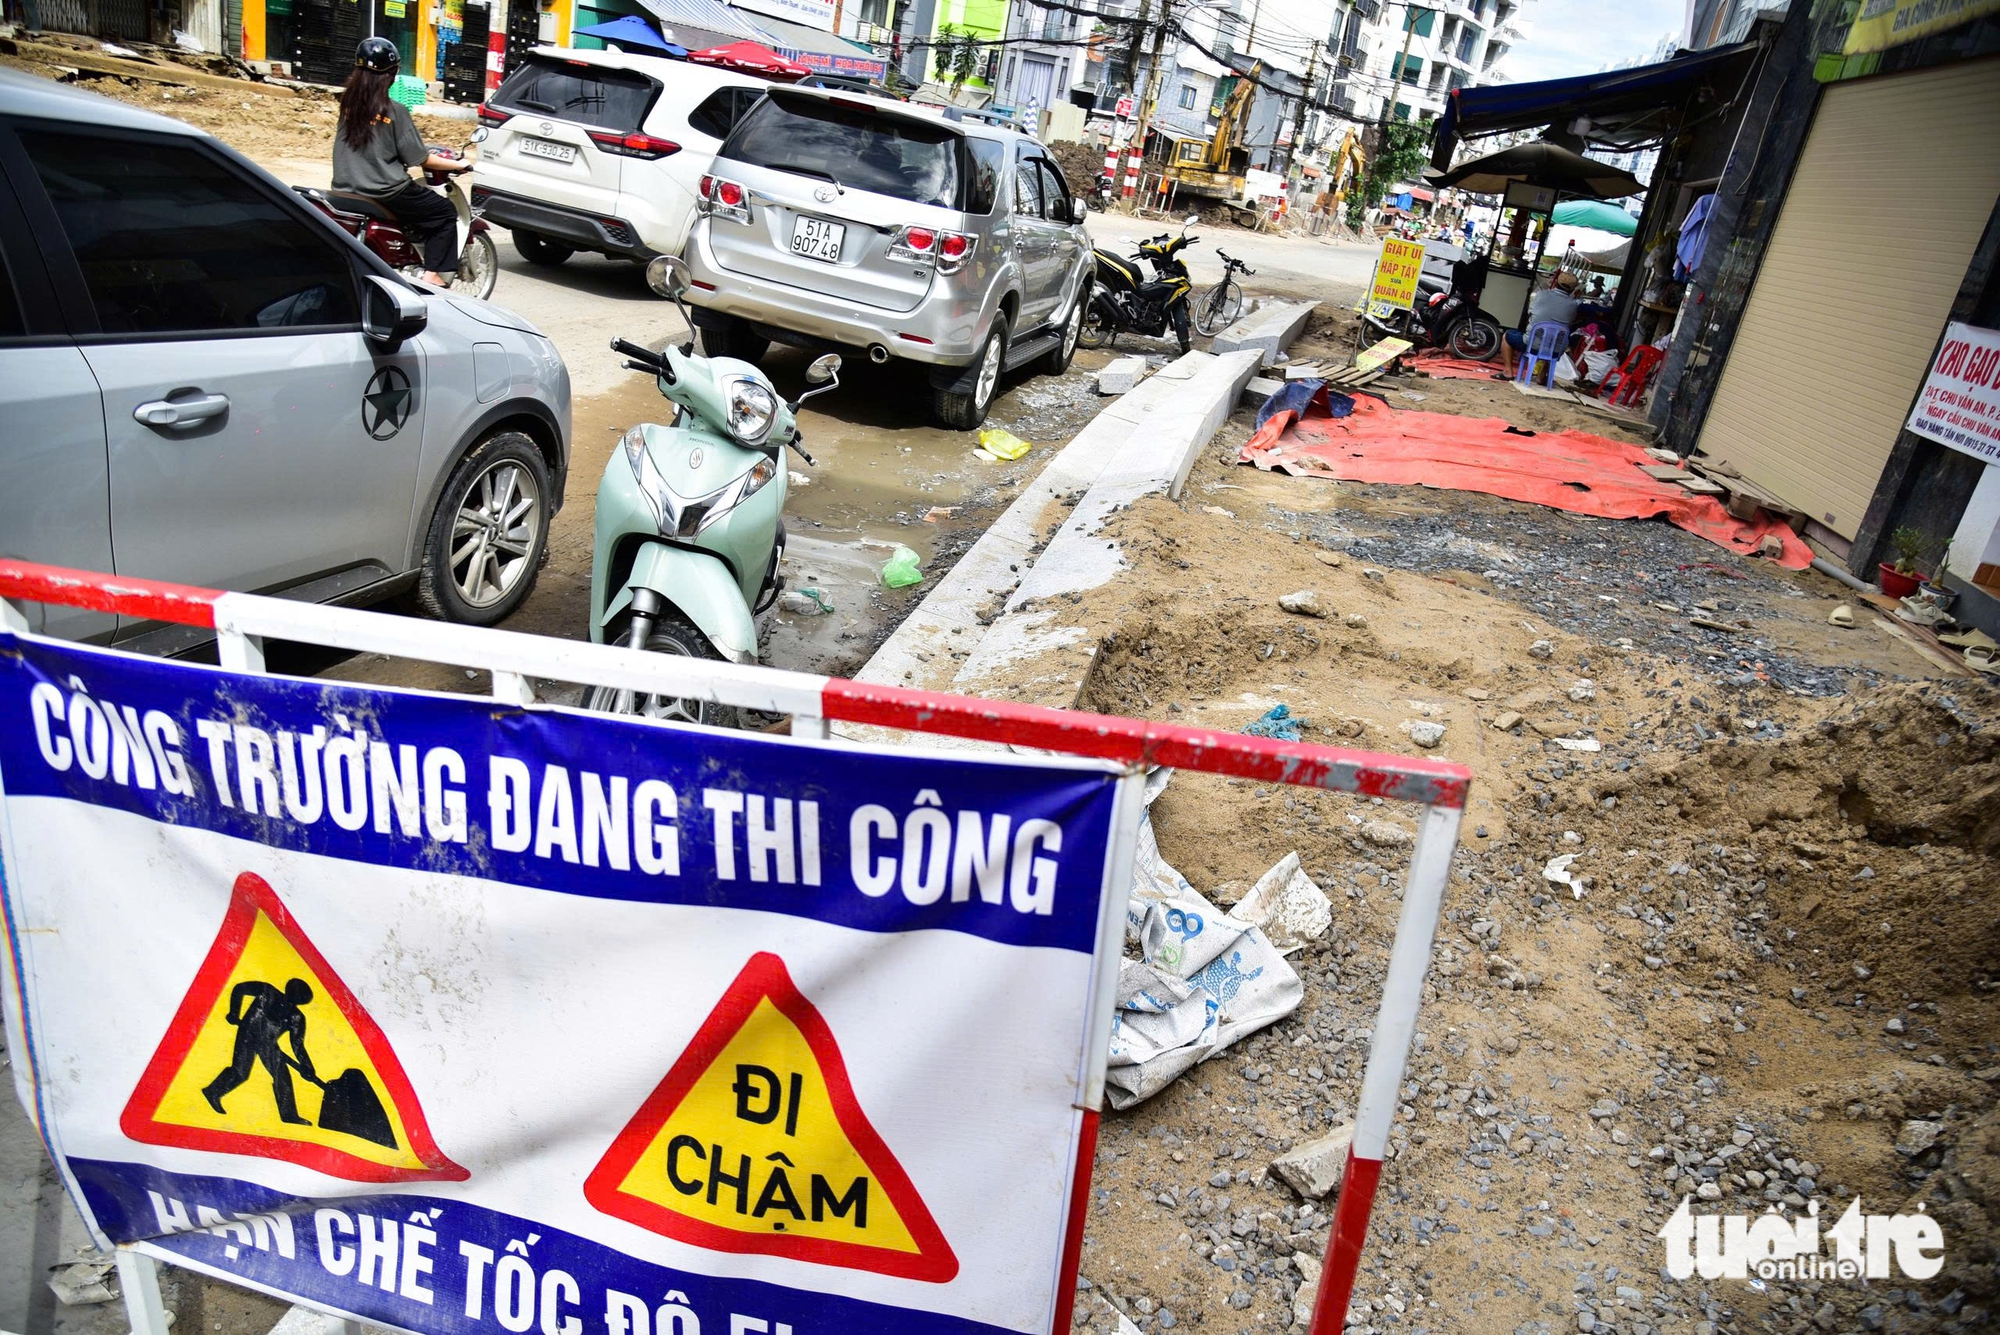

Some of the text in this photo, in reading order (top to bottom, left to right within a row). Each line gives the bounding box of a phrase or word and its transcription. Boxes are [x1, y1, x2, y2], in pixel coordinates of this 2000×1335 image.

[524, 140, 570, 159] 51K-930.25
[806, 220, 830, 240] 51A
[792, 235, 839, 259] 907.48
[1934, 339, 1970, 379] KHO
[1963, 345, 2000, 392] GẠO
[1940, 390, 1959, 406] CHU
[1957, 394, 1975, 412] VĂN
[1926, 405, 1948, 420] NGAY
[1960, 417, 1977, 431] CHU
[689, 436, 715, 447] HONDA
[30, 674, 1063, 916] CÔNG TRƯỜNG ĐANG THI CÔNG
[732, 1063, 803, 1137] ĐI
[666, 1134, 869, 1231] CHẬM
[146, 1190, 296, 1262] HẠN
[315, 1206, 444, 1305] CHẾ
[459, 1229, 582, 1335] TỐC
